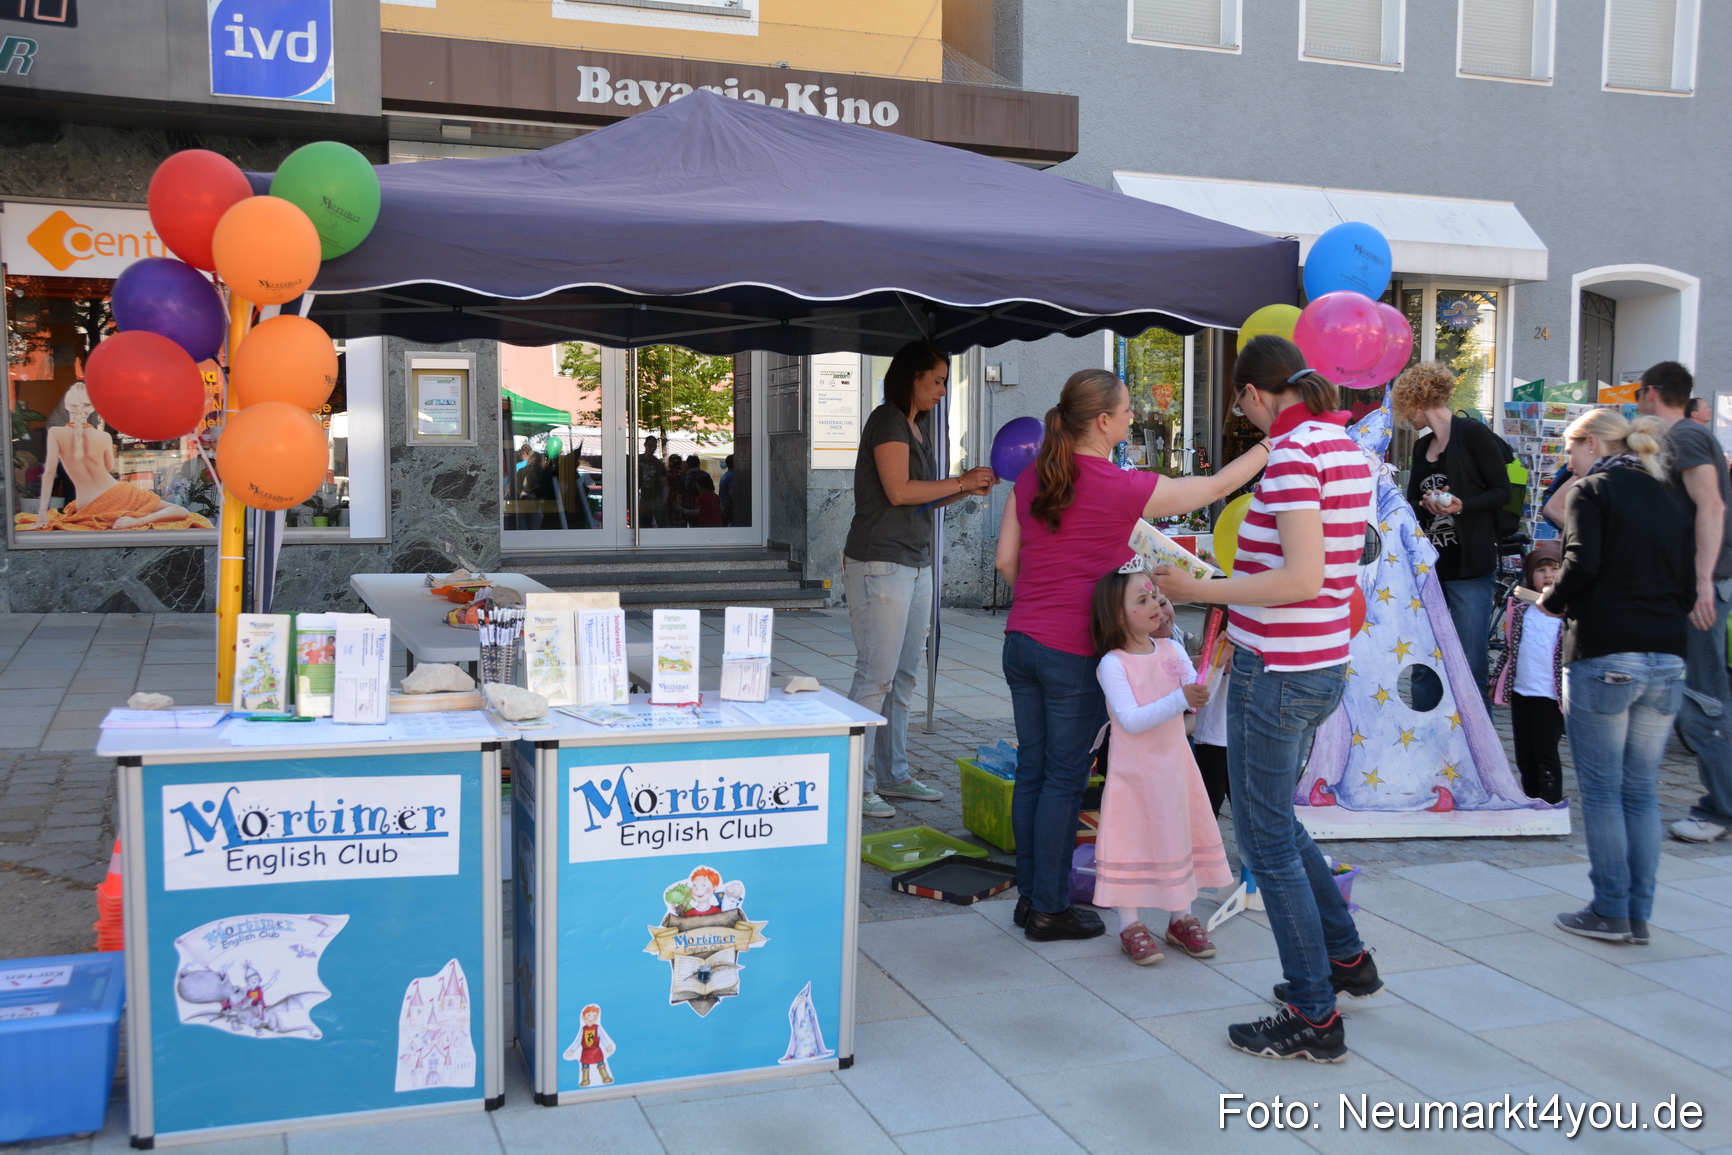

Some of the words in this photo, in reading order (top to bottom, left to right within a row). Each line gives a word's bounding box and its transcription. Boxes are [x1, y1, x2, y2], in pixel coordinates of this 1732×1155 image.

[224, 13, 317, 63] ivd
[1533, 325, 1550, 341] 24
[573, 766, 818, 833] Mortimer
[170, 786, 448, 856] Mortimer
[620, 819, 709, 850] English
[719, 817, 773, 840] Club
[226, 844, 326, 875] English
[338, 842, 398, 864] Club
[202, 917, 296, 950] Mortimer
[221, 933, 256, 950] English
[258, 930, 280, 939] Club
[672, 932, 736, 949] Mortimer
[683, 945, 708, 953] English
